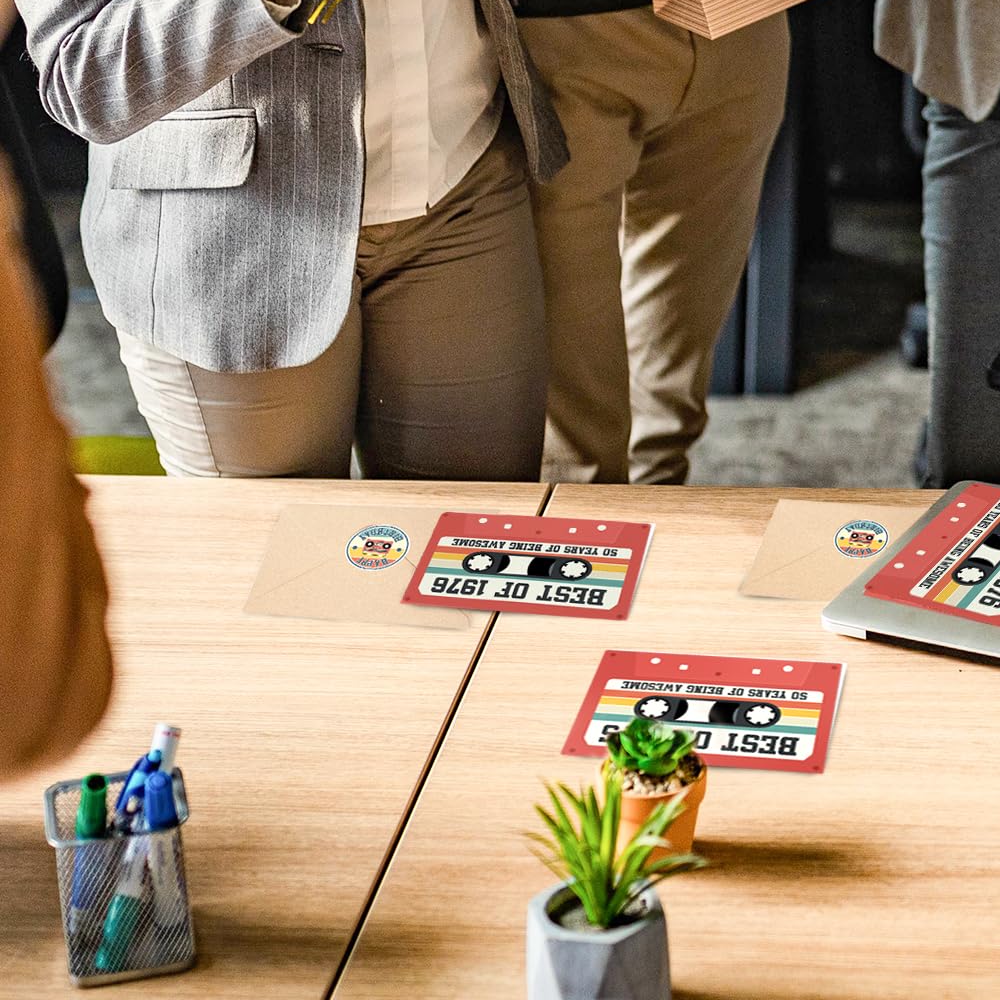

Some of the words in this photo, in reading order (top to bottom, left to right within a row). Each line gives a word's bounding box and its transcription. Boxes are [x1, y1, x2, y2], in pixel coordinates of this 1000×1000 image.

[980, 511, 1000, 529] YEARS
[970, 529, 984, 538] OF
[451, 538, 506, 549] AWESOME
[509, 541, 542, 551] BEING
[546, 543, 561, 552] OF
[951, 537, 975, 561] BEING
[563, 545, 599, 556] YEARS
[918, 552, 956, 590] AWESOME
[430, 576, 489, 596] 1976
[494, 581, 529, 600] OF
[536, 584, 608, 606] BEST
[621, 680, 683, 692] AWESOME
[686, 684, 724, 695] BEING
[727, 686, 743, 696] OF
[747, 688, 787, 699] YEARS
[721, 732, 800, 755] BEST
